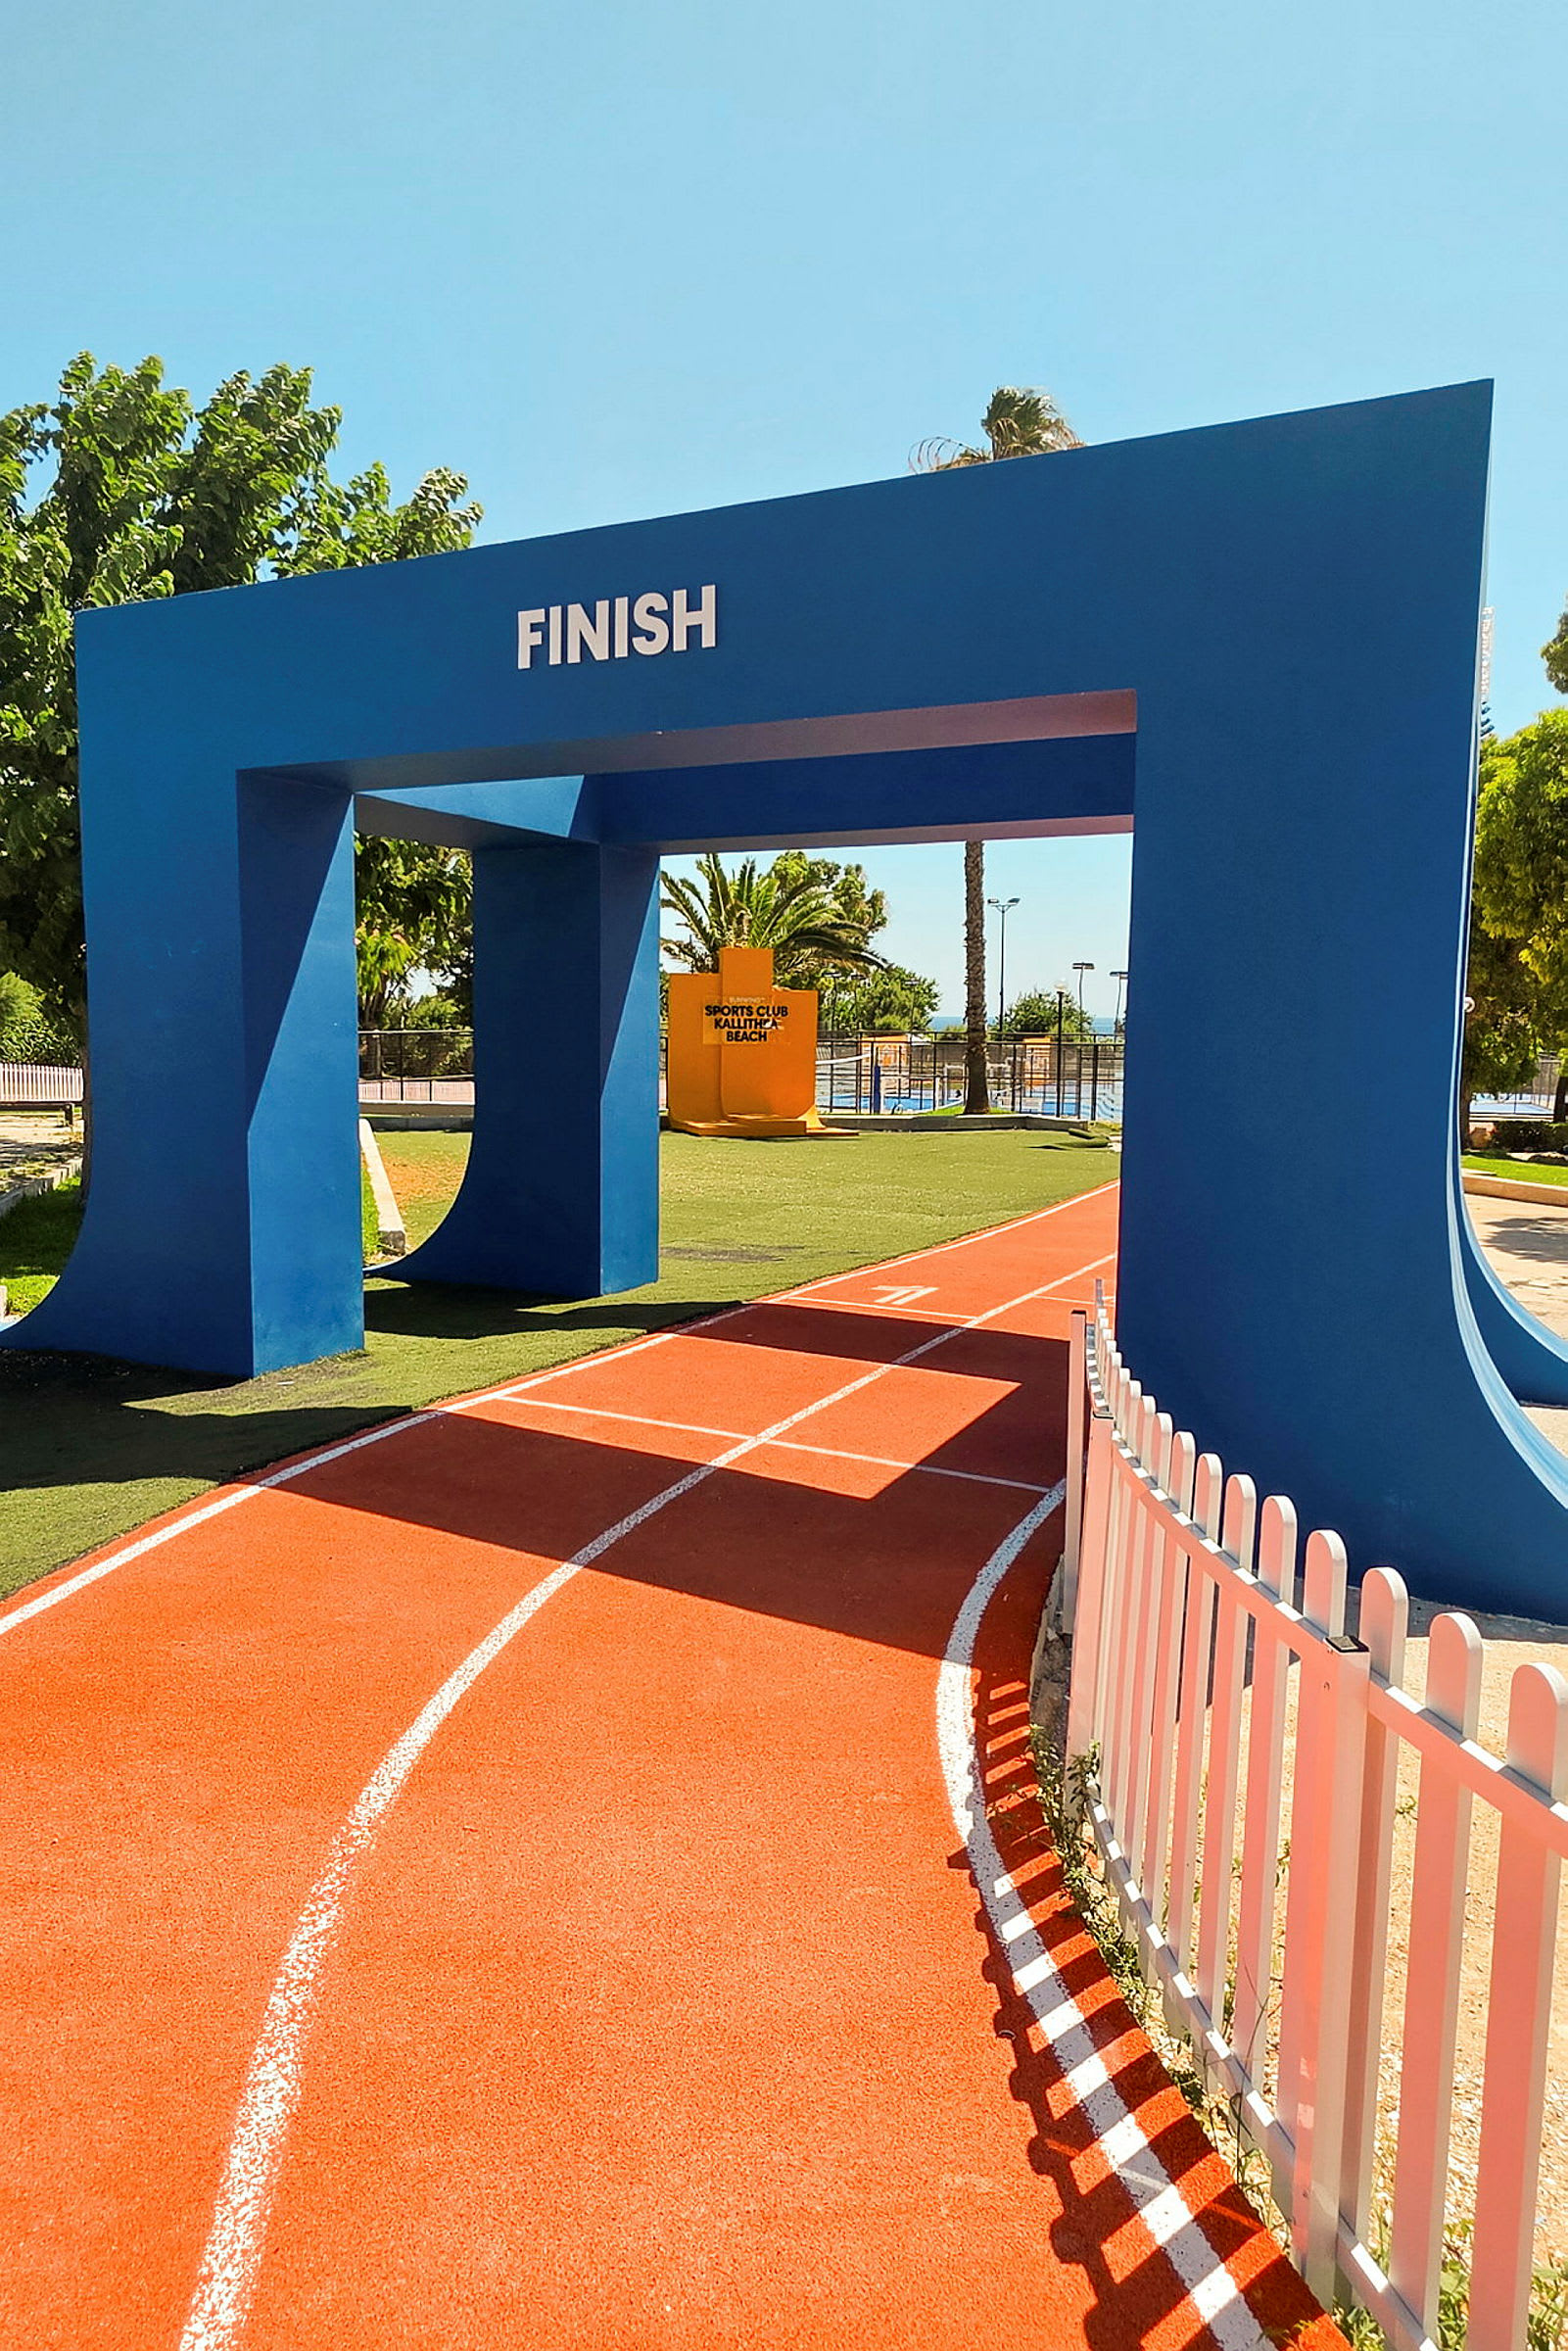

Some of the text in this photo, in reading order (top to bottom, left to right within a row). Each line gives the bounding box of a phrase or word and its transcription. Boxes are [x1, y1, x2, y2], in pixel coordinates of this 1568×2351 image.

[517, 585, 716, 670] FINISH
[704, 1004, 789, 1018] SPORTS CLUB
[727, 1031, 768, 1042] BEACH
